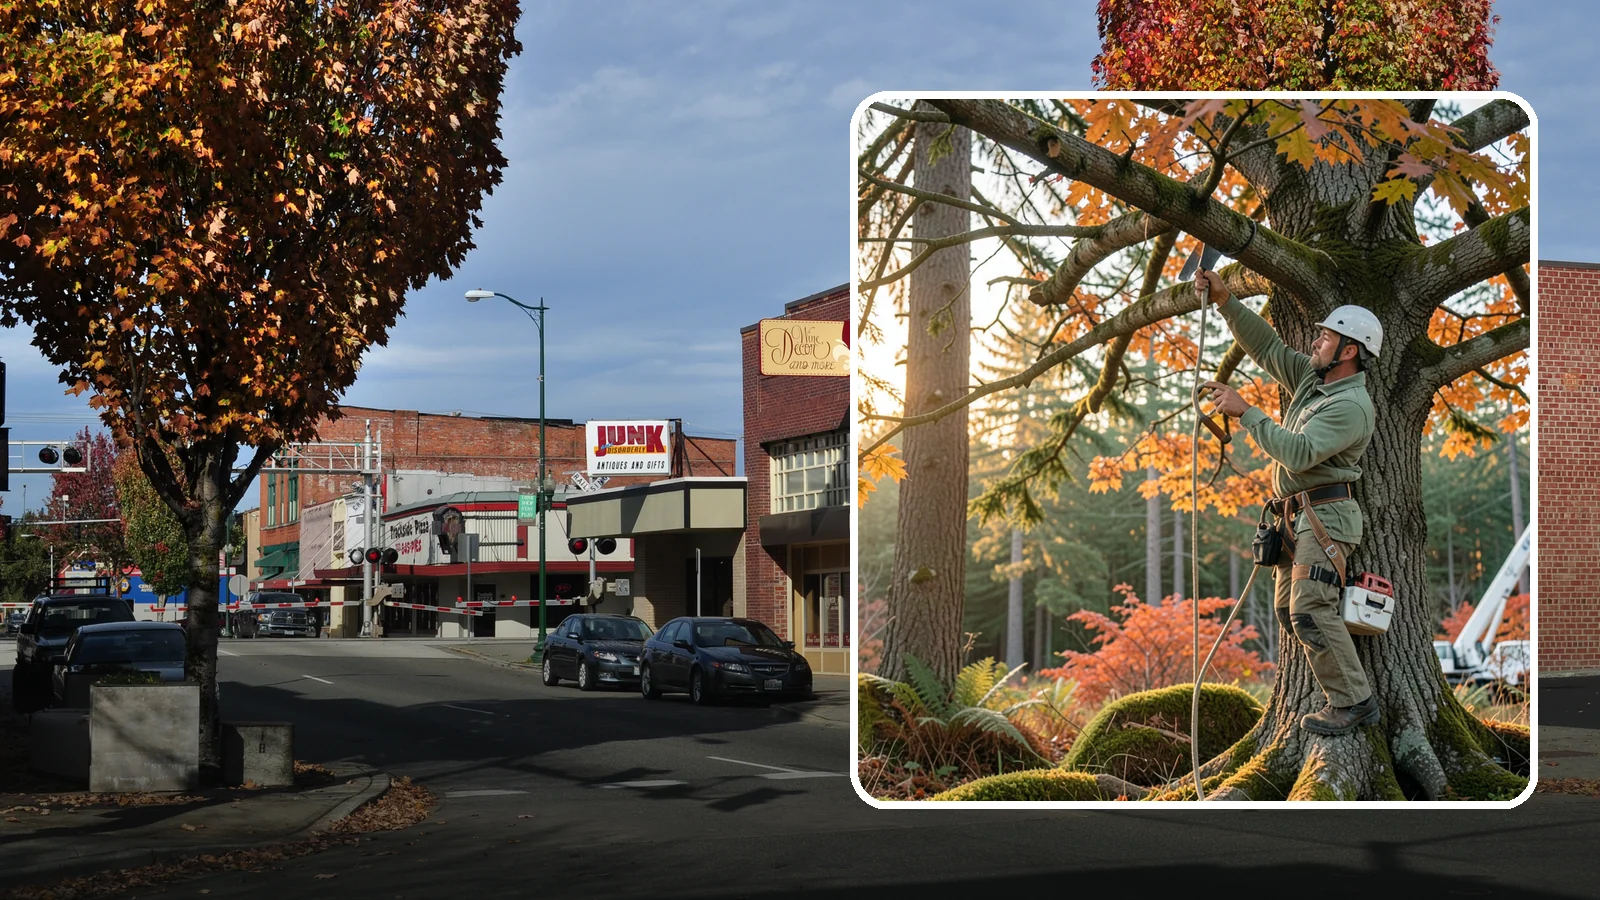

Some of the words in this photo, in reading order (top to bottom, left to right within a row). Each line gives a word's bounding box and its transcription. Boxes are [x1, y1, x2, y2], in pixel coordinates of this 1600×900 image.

[765, 328, 831, 365] Decor
[596, 425, 665, 457] JUNK
[607, 446, 646, 454] DISORDERLY
[597, 461, 628, 470] ANTIQUES
[631, 461, 644, 470] AND
[647, 460, 665, 470] GIFTS
[414, 519, 429, 535] Pizza
